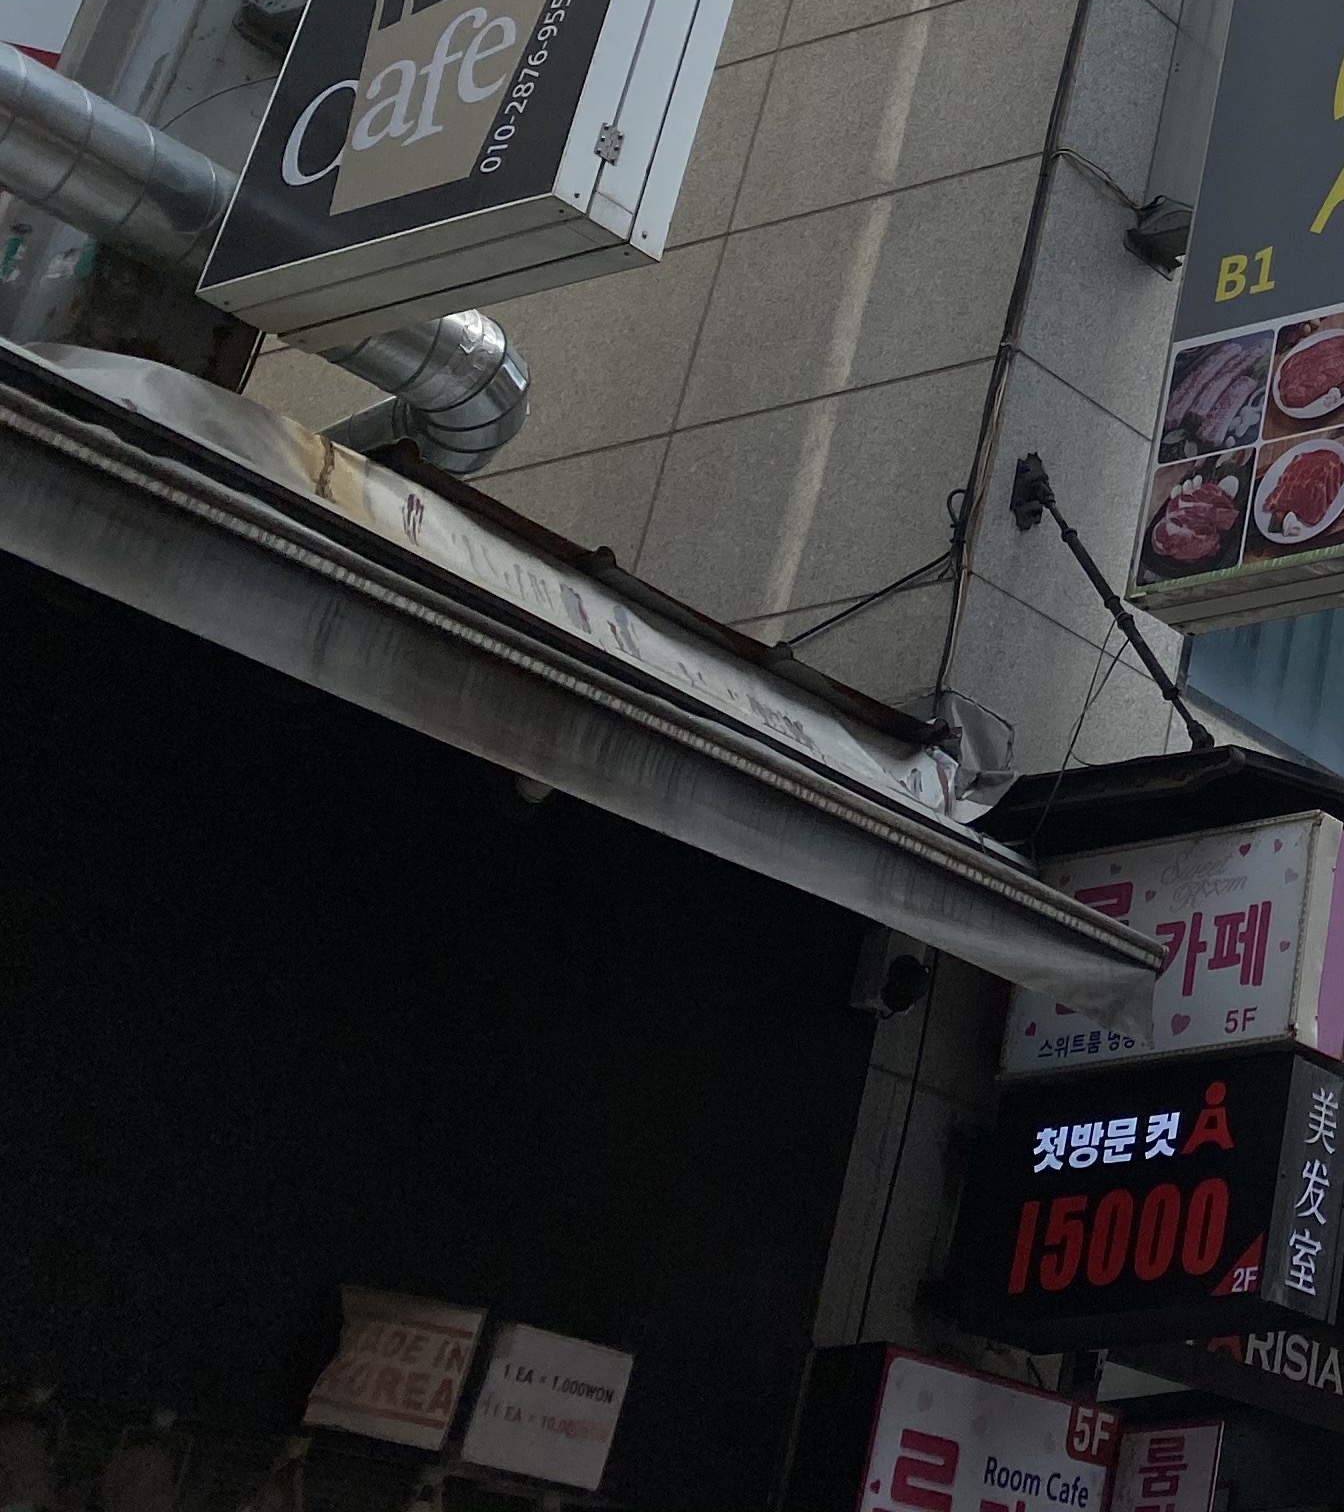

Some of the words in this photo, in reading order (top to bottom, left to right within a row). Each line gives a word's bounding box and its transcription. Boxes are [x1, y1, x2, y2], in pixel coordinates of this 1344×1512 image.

[281, 6, 518, 187] Cafe
[1213, 246, 1277, 303] B1
[1223, 1006, 1259, 1035] 5F
[1032, 1115, 1138, 1174] 첫방문
[1284, 1087, 1340, 1297] 美发室
[1006, 1175, 1233, 1296] 15000
[1231, 1265, 1260, 1294] 2F
[1072, 1406, 1117, 1457] 5F
[983, 1456, 1040, 1498] Room
[1047, 1472, 1090, 1510] Cafe
